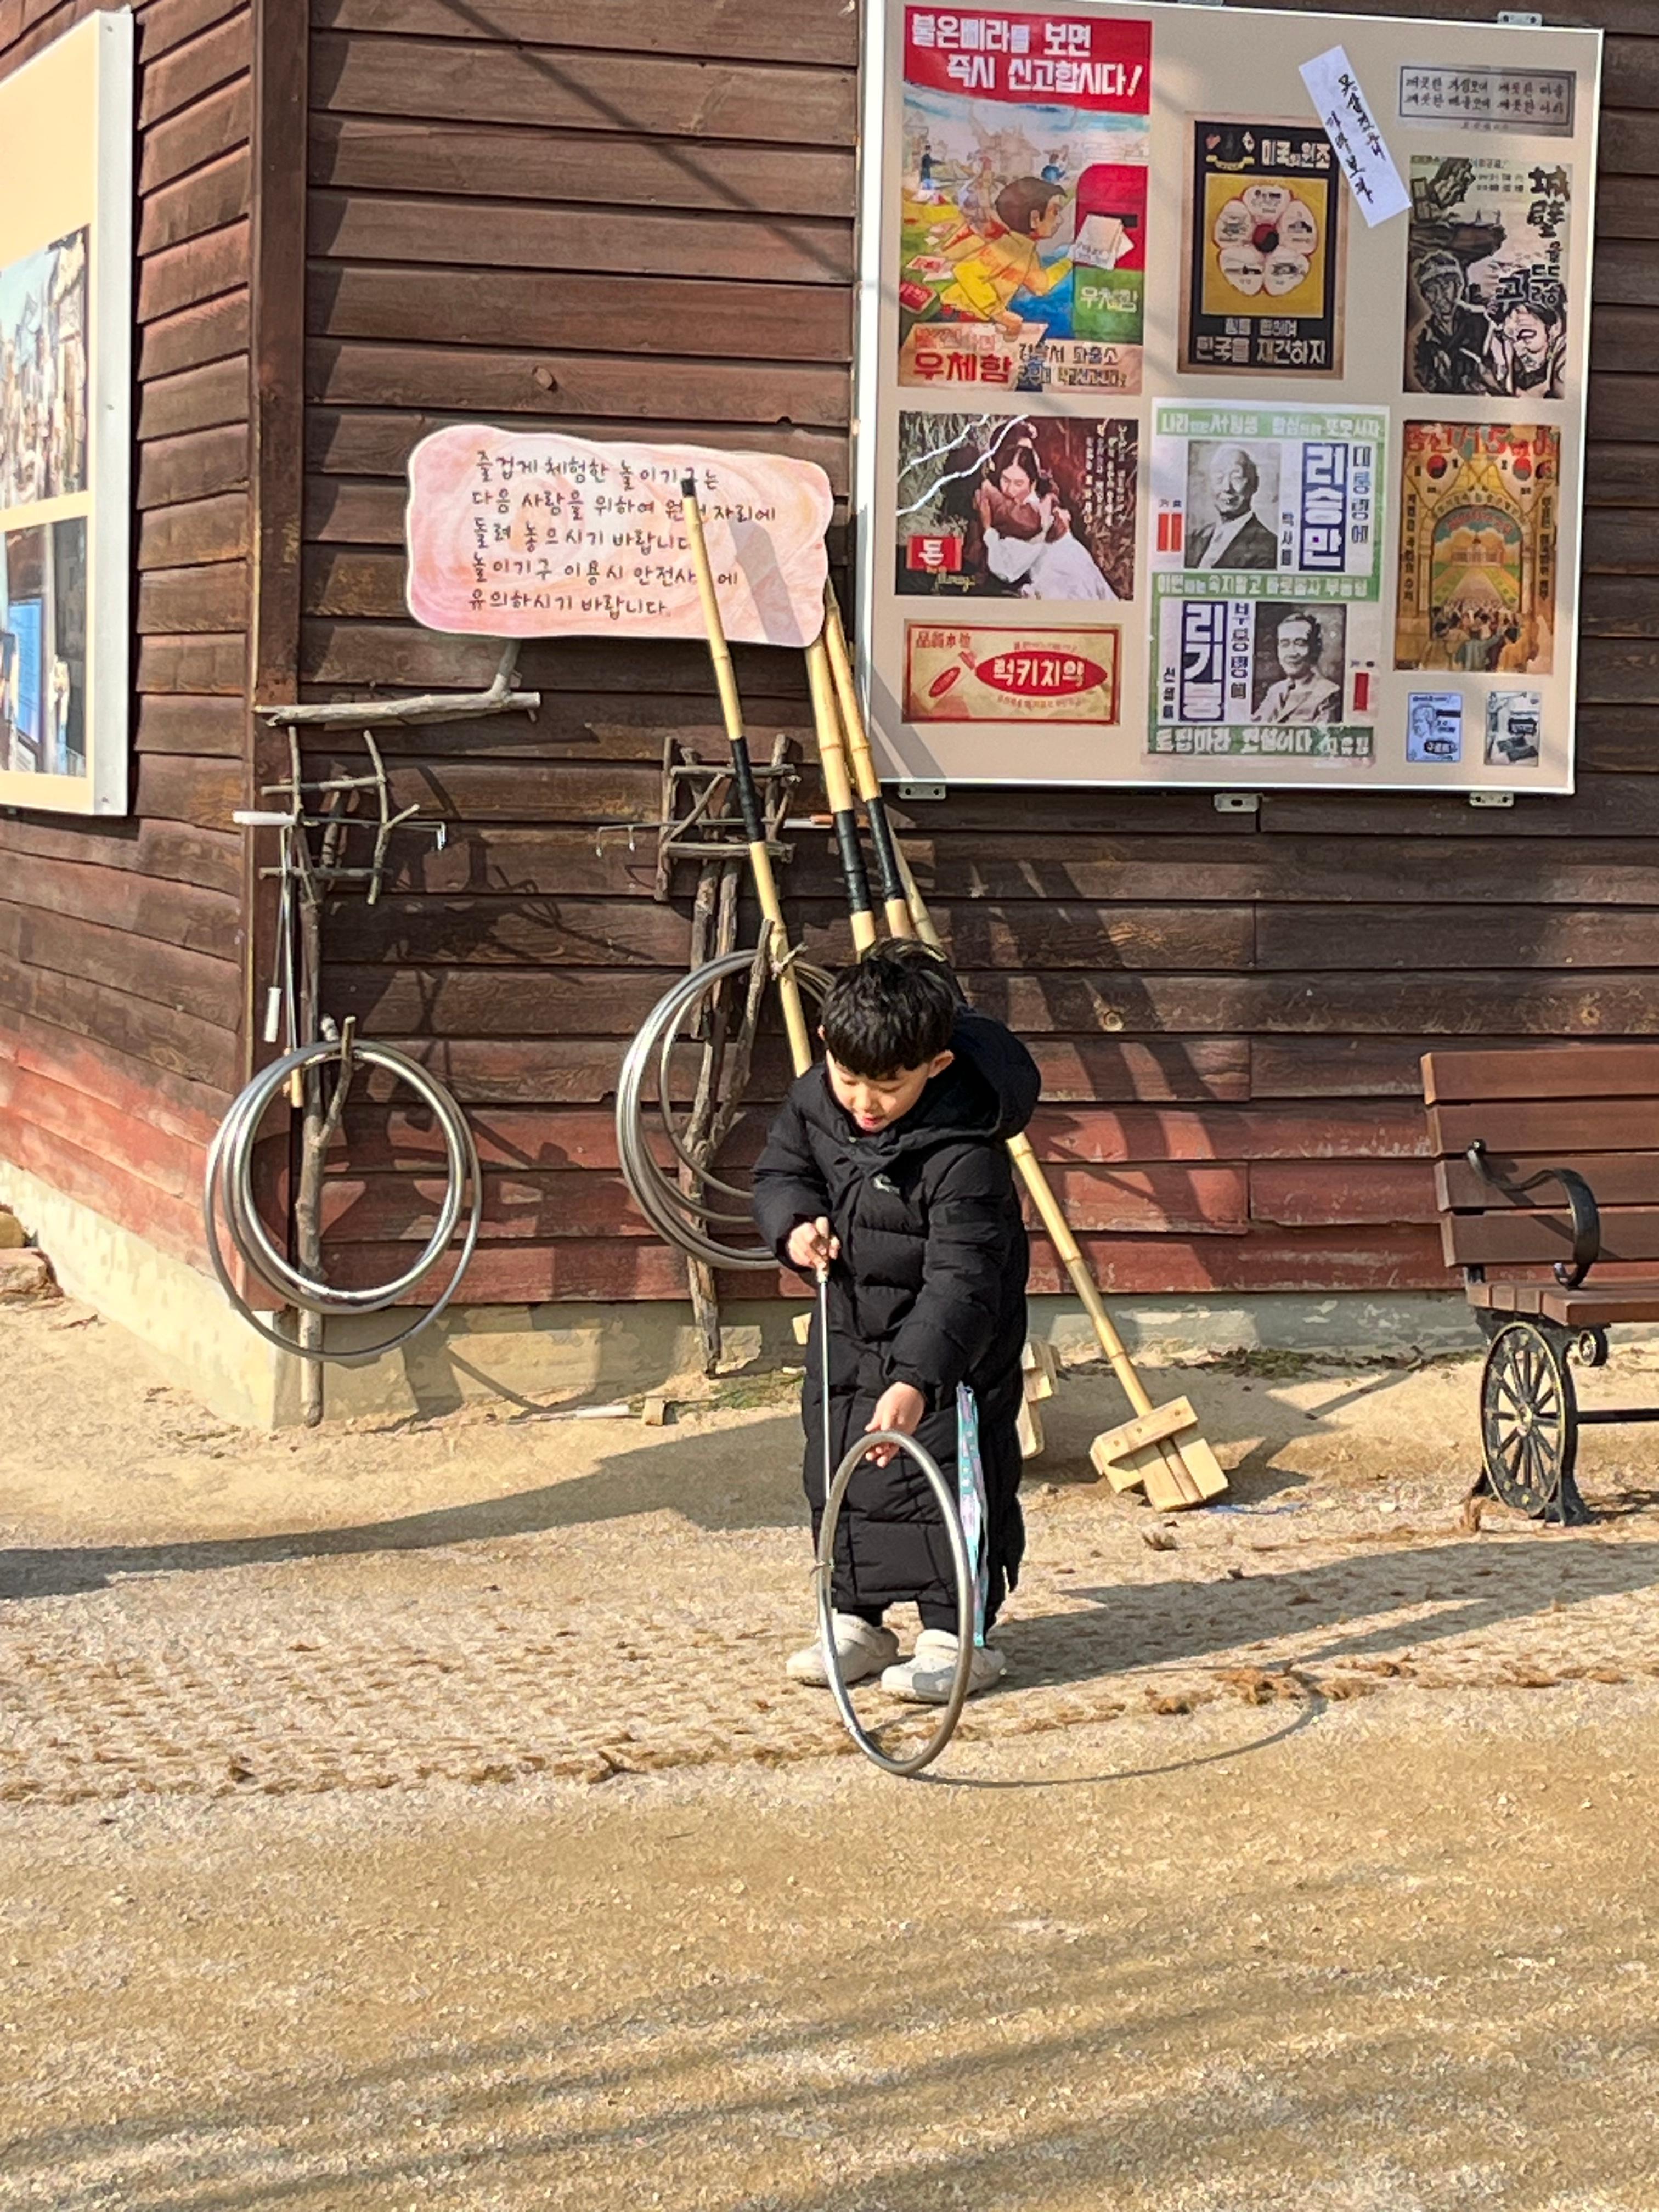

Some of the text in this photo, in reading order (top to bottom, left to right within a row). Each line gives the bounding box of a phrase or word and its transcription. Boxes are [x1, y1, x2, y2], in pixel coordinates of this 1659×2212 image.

[1044, 22, 1091, 57] 보면
[947, 54, 1143, 97] 즉시 신고합시다!
[914, 352, 1012, 383] 우체함
[476, 450, 538, 482] 즐겁게
[545, 456, 609, 483] 체험한
[472, 488, 511, 514] 다음
[522, 490, 584, 521] 사람을
[594, 495, 654, 517] 위하여
[713, 504, 776, 523] 자리에
[1304, 445, 1344, 566] 리승만
[473, 517, 511, 549] 돌려
[523, 521, 604, 552] 놓으시기
[472, 552, 738, 587] 놀이기구 이용시 안전사에
[469, 588, 573, 611] 유의하시기
[993, 658, 1085, 687] 럭키치약
[1183, 605, 1223, 719] 리기붕
